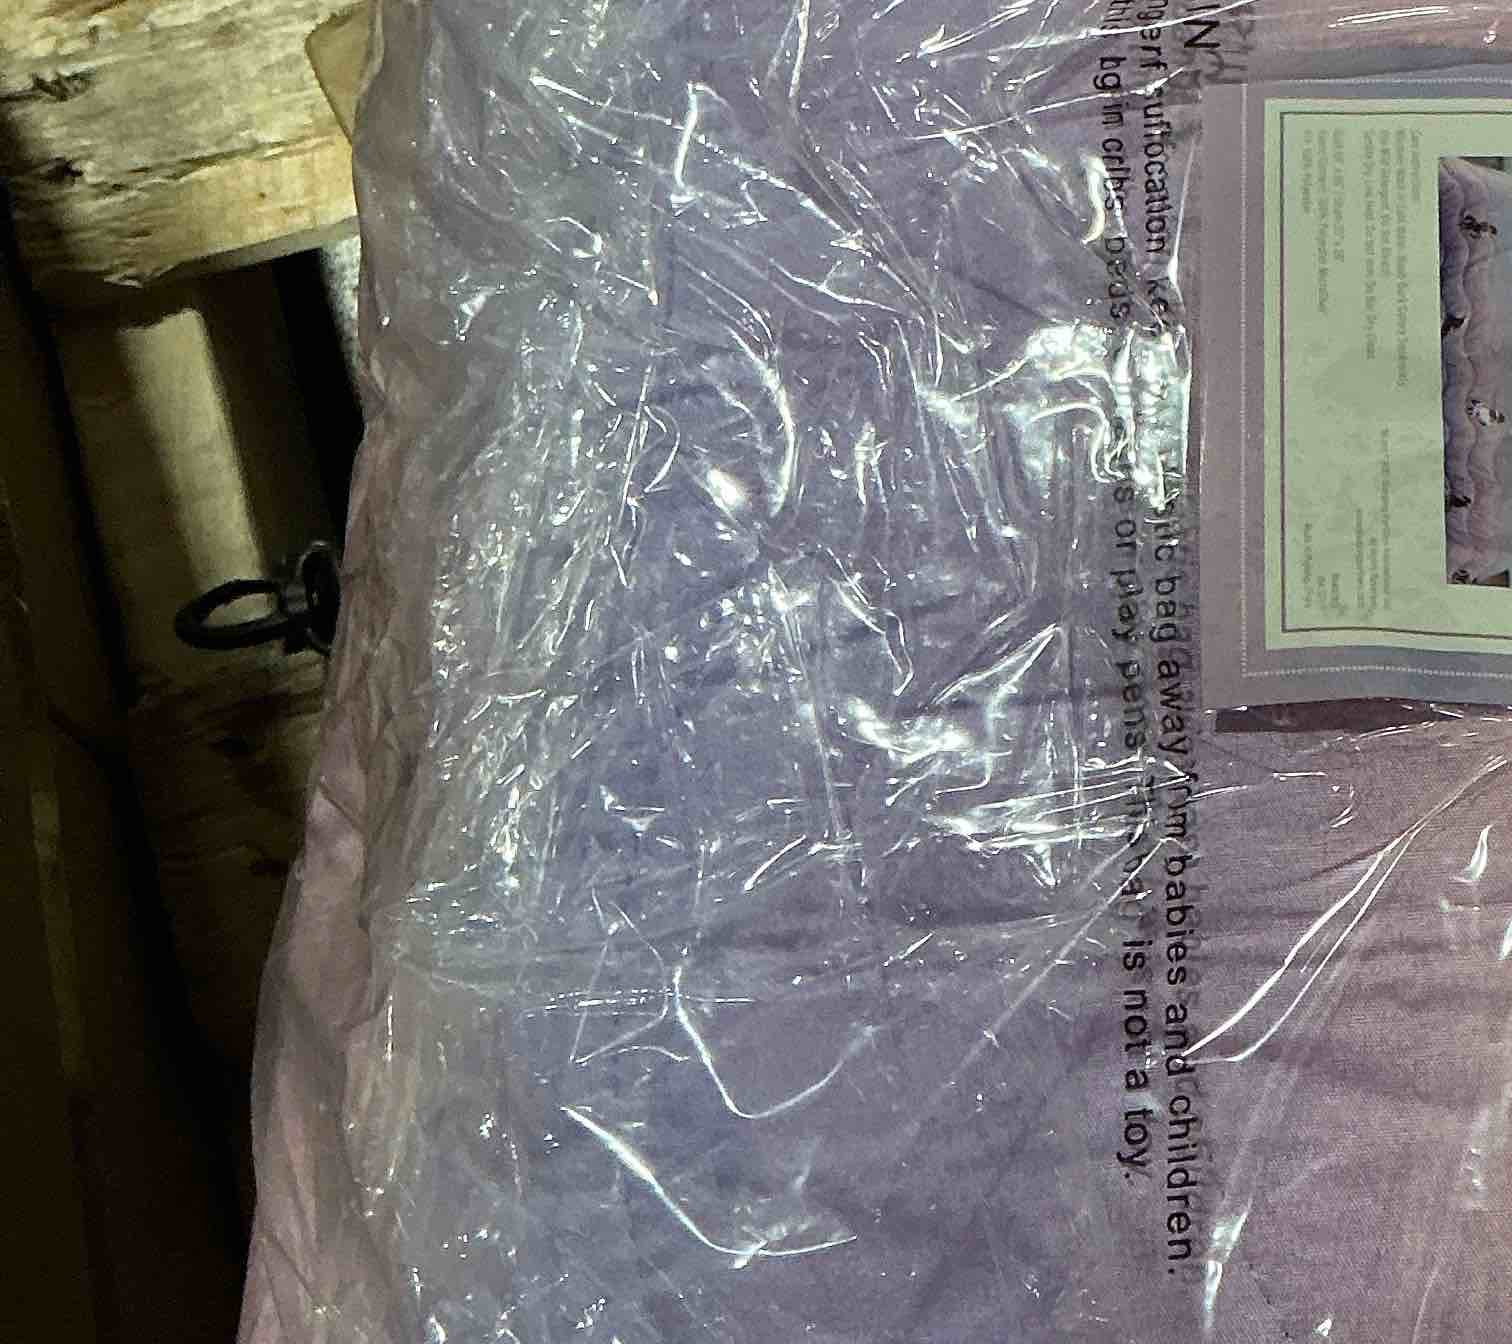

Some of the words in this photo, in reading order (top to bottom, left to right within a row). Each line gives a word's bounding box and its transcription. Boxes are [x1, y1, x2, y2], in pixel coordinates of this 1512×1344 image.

[1111, 568, 1145, 644] play
[1149, 575, 1183, 643] bag
[1157, 659, 1189, 755] away
[1122, 939, 1153, 972] is
[1165, 854, 1195, 986] babies
[1123, 989, 1152, 1052] not
[1165, 1004, 1196, 1077] and
[1124, 1068, 1150, 1090] a
[1116, 1108, 1154, 1180] toy.
[1166, 1095, 1198, 1275] children.
